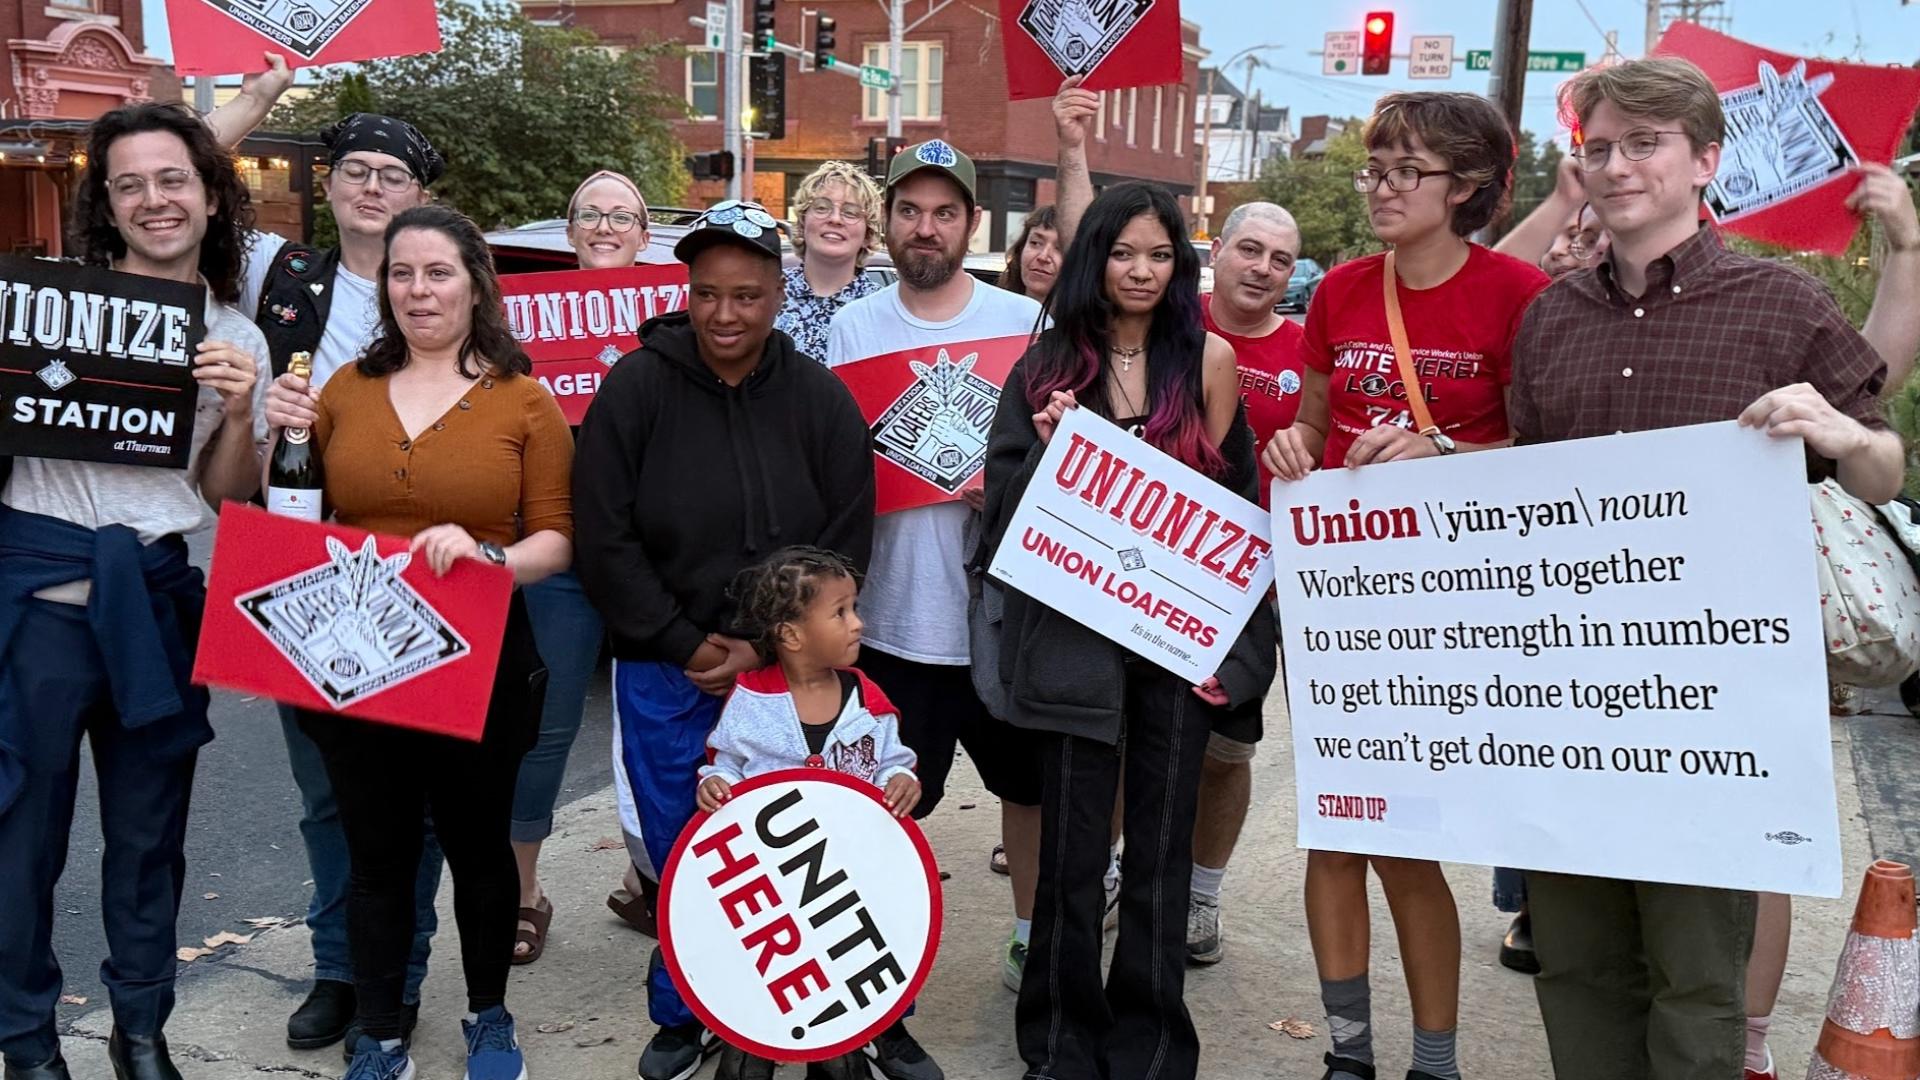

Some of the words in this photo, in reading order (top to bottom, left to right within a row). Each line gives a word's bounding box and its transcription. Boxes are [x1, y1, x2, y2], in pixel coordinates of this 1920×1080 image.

[228, 5, 255, 23] UNION
[255, 20, 293, 45] LOAFERS
[317, 21, 339, 43] UNION
[339, 0, 368, 23] BAKEH
[1083, 51, 1103, 71] UNION
[1101, 13, 1137, 53] BAKEHOUSE
[1419, 53, 1444, 62] TURN
[1424, 40, 1440, 49] NO
[1527, 55, 1558, 70] rove
[1412, 65, 1426, 74] ON
[1428, 65, 1448, 74] RED
[0, 280, 190, 366] IONIZE
[503, 284, 689, 343] UNIONIZ
[1334, 349, 1395, 373] UNITE
[1369, 343, 1384, 351] and
[1384, 344, 1394, 352] Fo
[1463, 351, 1483, 360] Union
[880, 408, 896, 427] THE
[894, 384, 924, 414] STATION
[967, 376, 993, 395] BAGEL
[13, 396, 175, 436] STATION
[885, 395, 940, 451] LOAFERS
[952, 389, 998, 441] UNIO
[113, 440, 125, 450] at
[125, 440, 171, 454] Thurman
[885, 449, 906, 465] UNION
[905, 459, 938, 482] LOAFERS
[961, 459, 984, 480] UNION
[1055, 432, 1272, 594] UNIONIZE
[1290, 498, 1421, 546] Union
[1598, 490, 1688, 522] noun
[1022, 526, 1103, 586] UNION
[1102, 572, 1219, 648] LOAFERS
[1297, 565, 1415, 599] Workers
[1421, 558, 1534, 597] coming
[1540, 548, 1685, 595] together
[1130, 623, 1144, 637] It's
[1142, 630, 1152, 641] in
[1151, 635, 1166, 649] the
[1304, 626, 1330, 652] to
[1337, 628, 1381, 651] use
[1387, 626, 1436, 651] our
[1443, 613, 1574, 657] strength
[1579, 613, 1615, 648] in
[1621, 608, 1790, 647] numbers
[1309, 678, 1336, 705] to
[1341, 677, 1382, 713] get
[1387, 674, 1478, 715] things
[1484, 674, 1562, 709] done
[1569, 674, 1718, 718] together
[1314, 736, 1351, 758] we
[1358, 732, 1424, 762] can't
[1429, 735, 1472, 771] get
[1478, 732, 1554, 768] done
[1562, 744, 1605, 771] on
[1611, 746, 1671, 773] our
[1680, 748, 1769, 778] own.
[1318, 793, 1364, 821] STAND
[1365, 797, 1388, 822] UP
[754, 788, 907, 1010] UNITE
[691, 822, 848, 1040] HERE!
